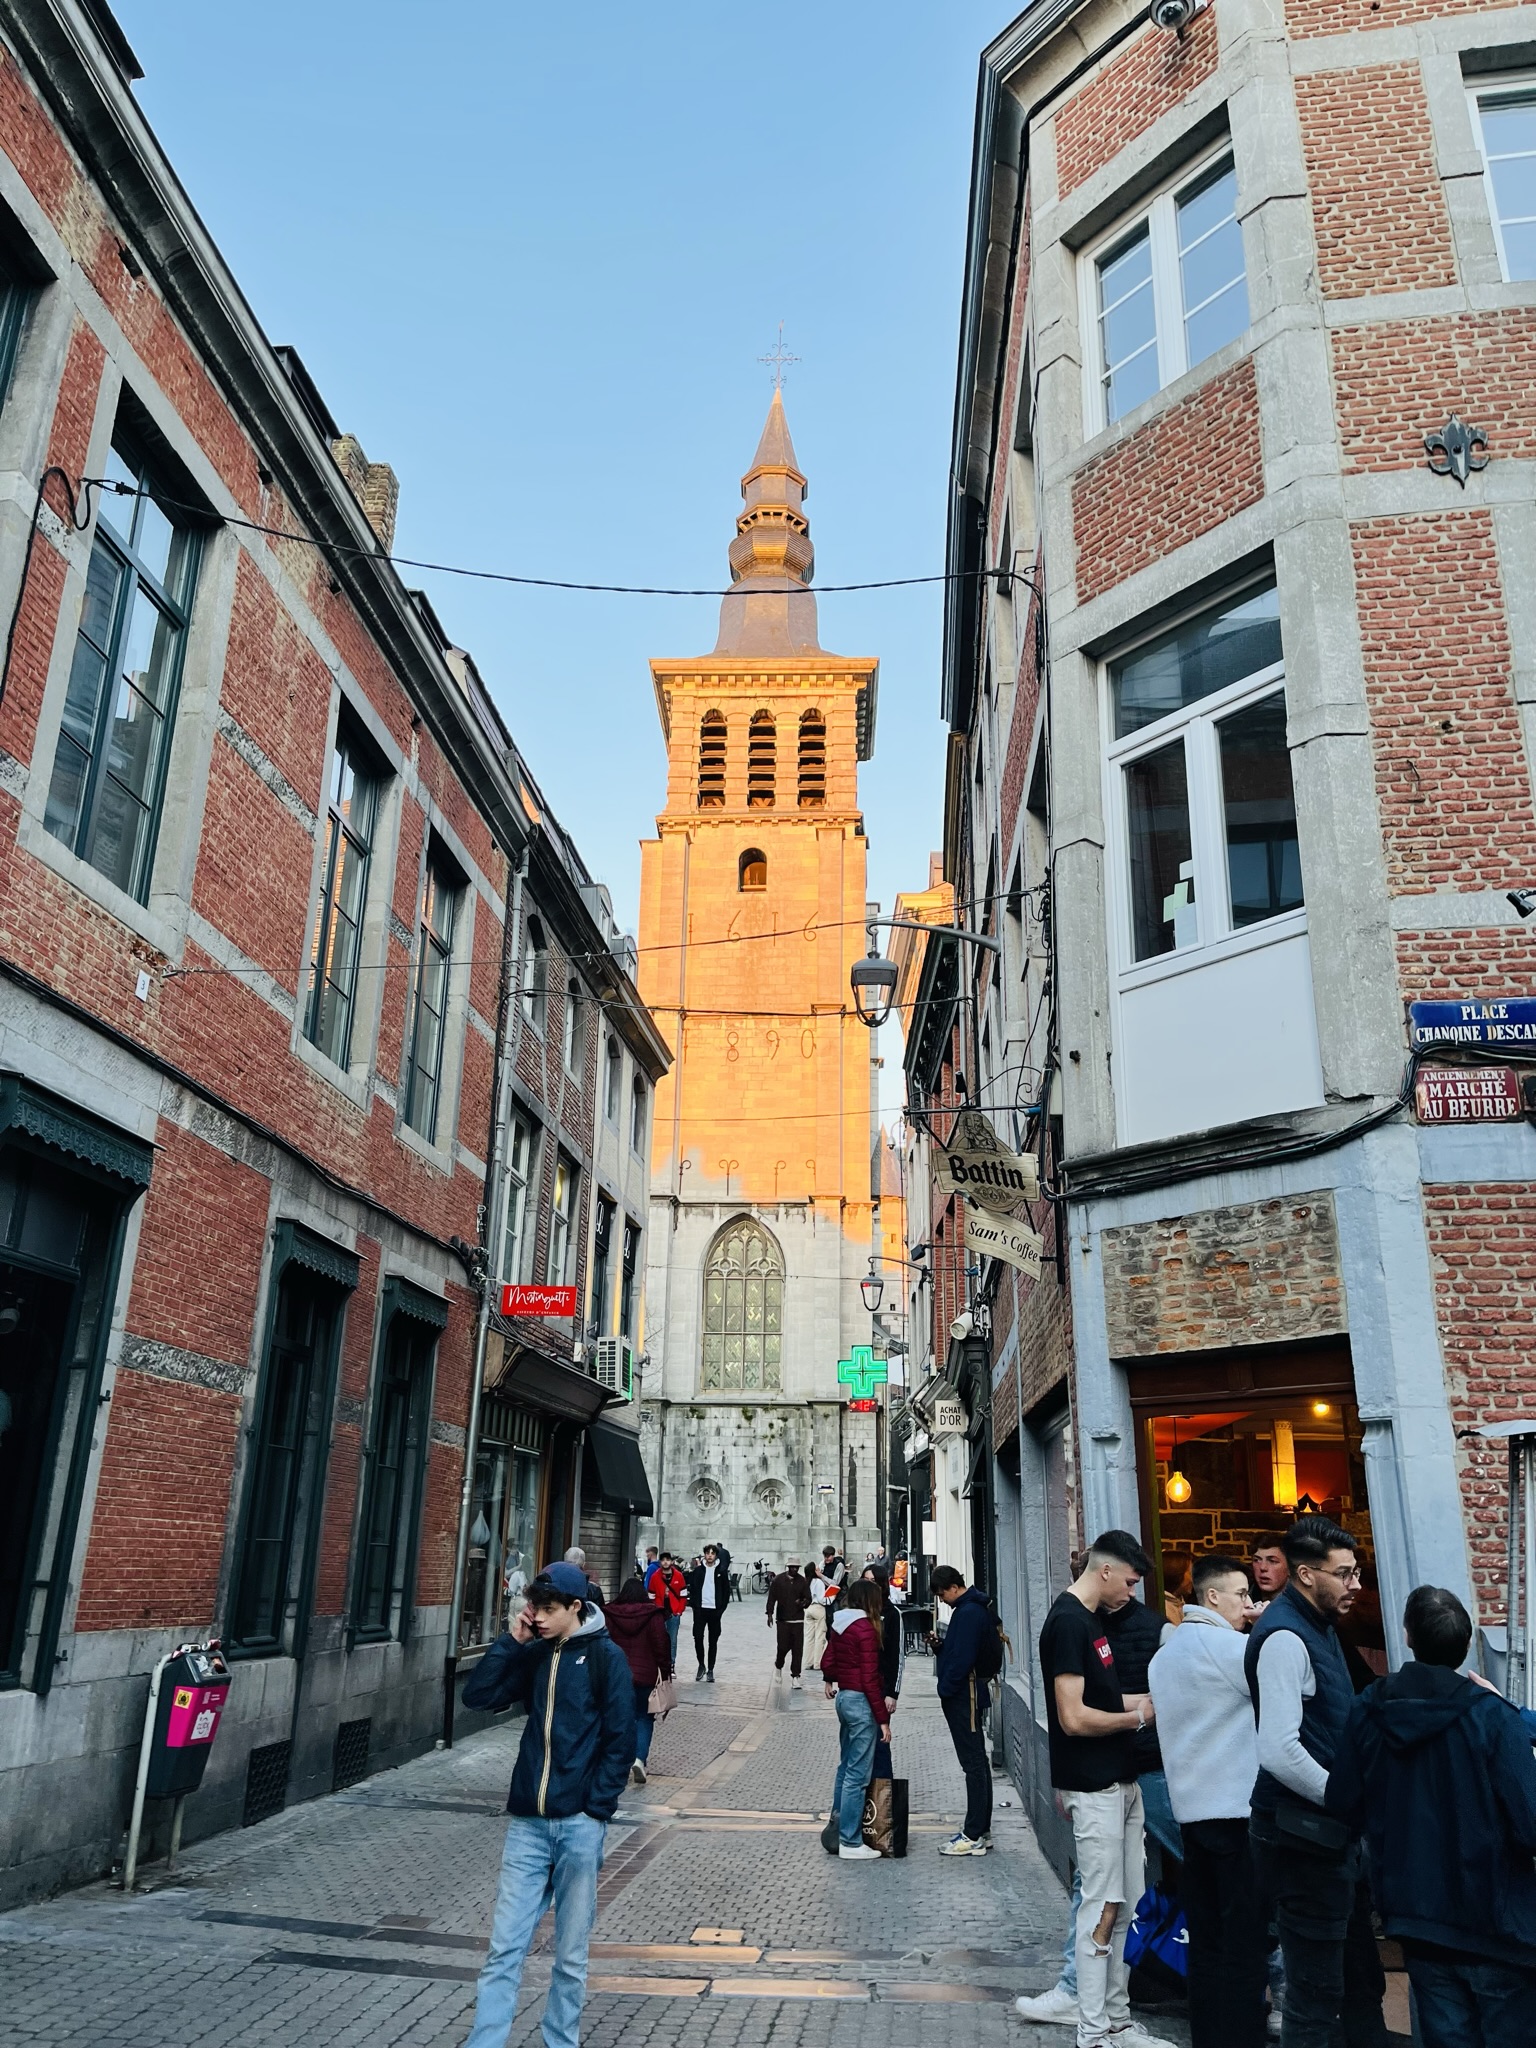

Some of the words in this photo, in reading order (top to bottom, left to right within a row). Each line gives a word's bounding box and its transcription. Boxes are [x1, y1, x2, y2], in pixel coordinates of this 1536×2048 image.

[1461, 1004, 1509, 1021] PLACE
[1416, 1025, 1482, 1043] CHANOINE
[1423, 1070, 1506, 1082] ANCIENNEMENT
[1428, 1079, 1507, 1098] MARCHÉ
[1423, 1100, 1443, 1119] AU
[1448, 1097, 1517, 1118] BEURRE
[948, 1154, 1026, 1191] Battin
[968, 1221, 1009, 1245] Sam's
[1010, 1235, 1039, 1262] Coffee
[940, 1406, 962, 1414] ACHAT
[940, 1414, 962, 1426] D'OR
